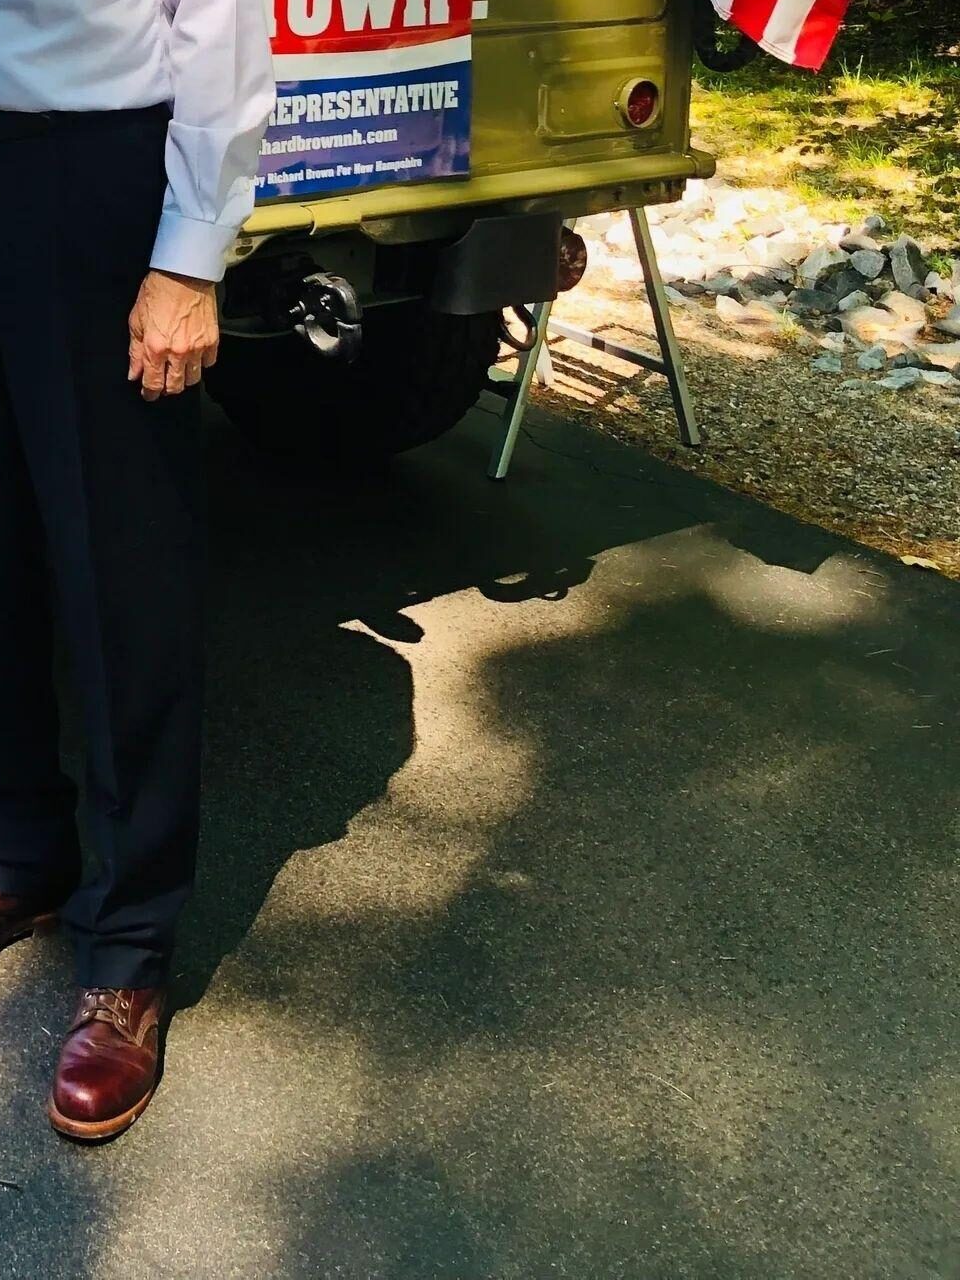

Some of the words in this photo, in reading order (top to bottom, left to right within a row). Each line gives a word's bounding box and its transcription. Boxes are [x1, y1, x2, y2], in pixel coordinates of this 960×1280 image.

[268, 81, 459, 126] EPRESENTATIVE
[259, 128, 398, 155] hardbrownnh.com
[268, 169, 304, 184] Richard
[306, 168, 334, 180] Brown
[375, 157, 422, 172] Hampshire
